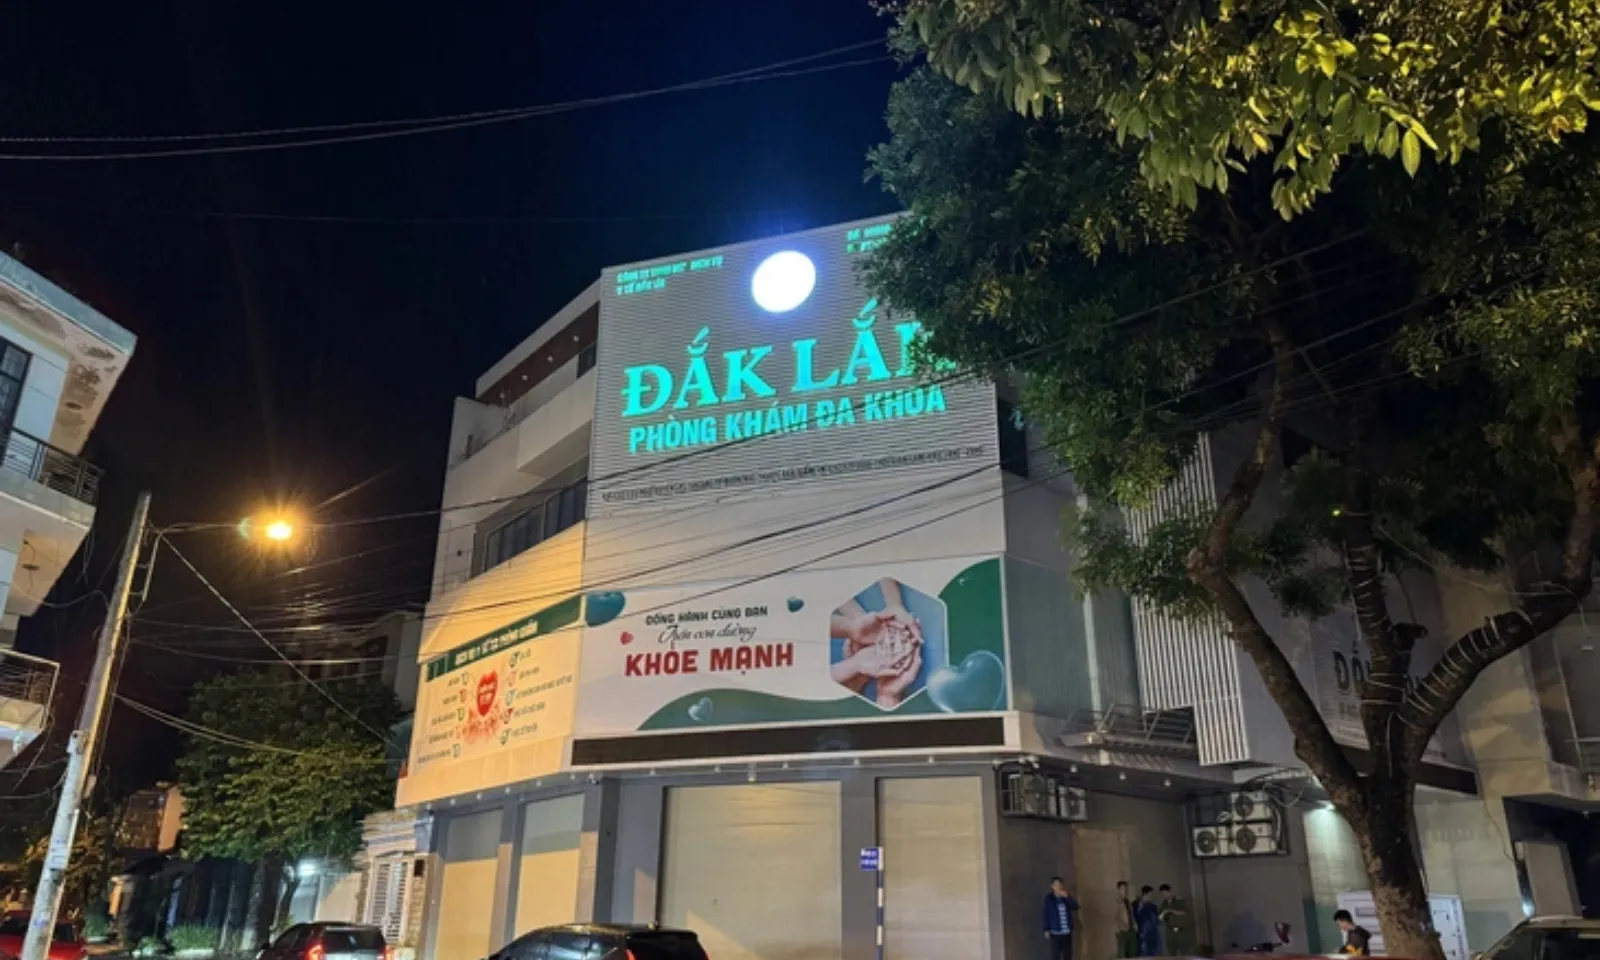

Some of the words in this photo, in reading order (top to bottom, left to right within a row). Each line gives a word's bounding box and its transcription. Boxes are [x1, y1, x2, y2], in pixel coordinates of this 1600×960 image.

[621, 326, 777, 417] ĐẮK
[629, 414, 717, 454] PHÒNG
[725, 401, 808, 440] KHÁM
[815, 396, 856, 428] ĐA
[864, 384, 946, 421] KHOA
[709, 642, 793, 676] MẠNH
